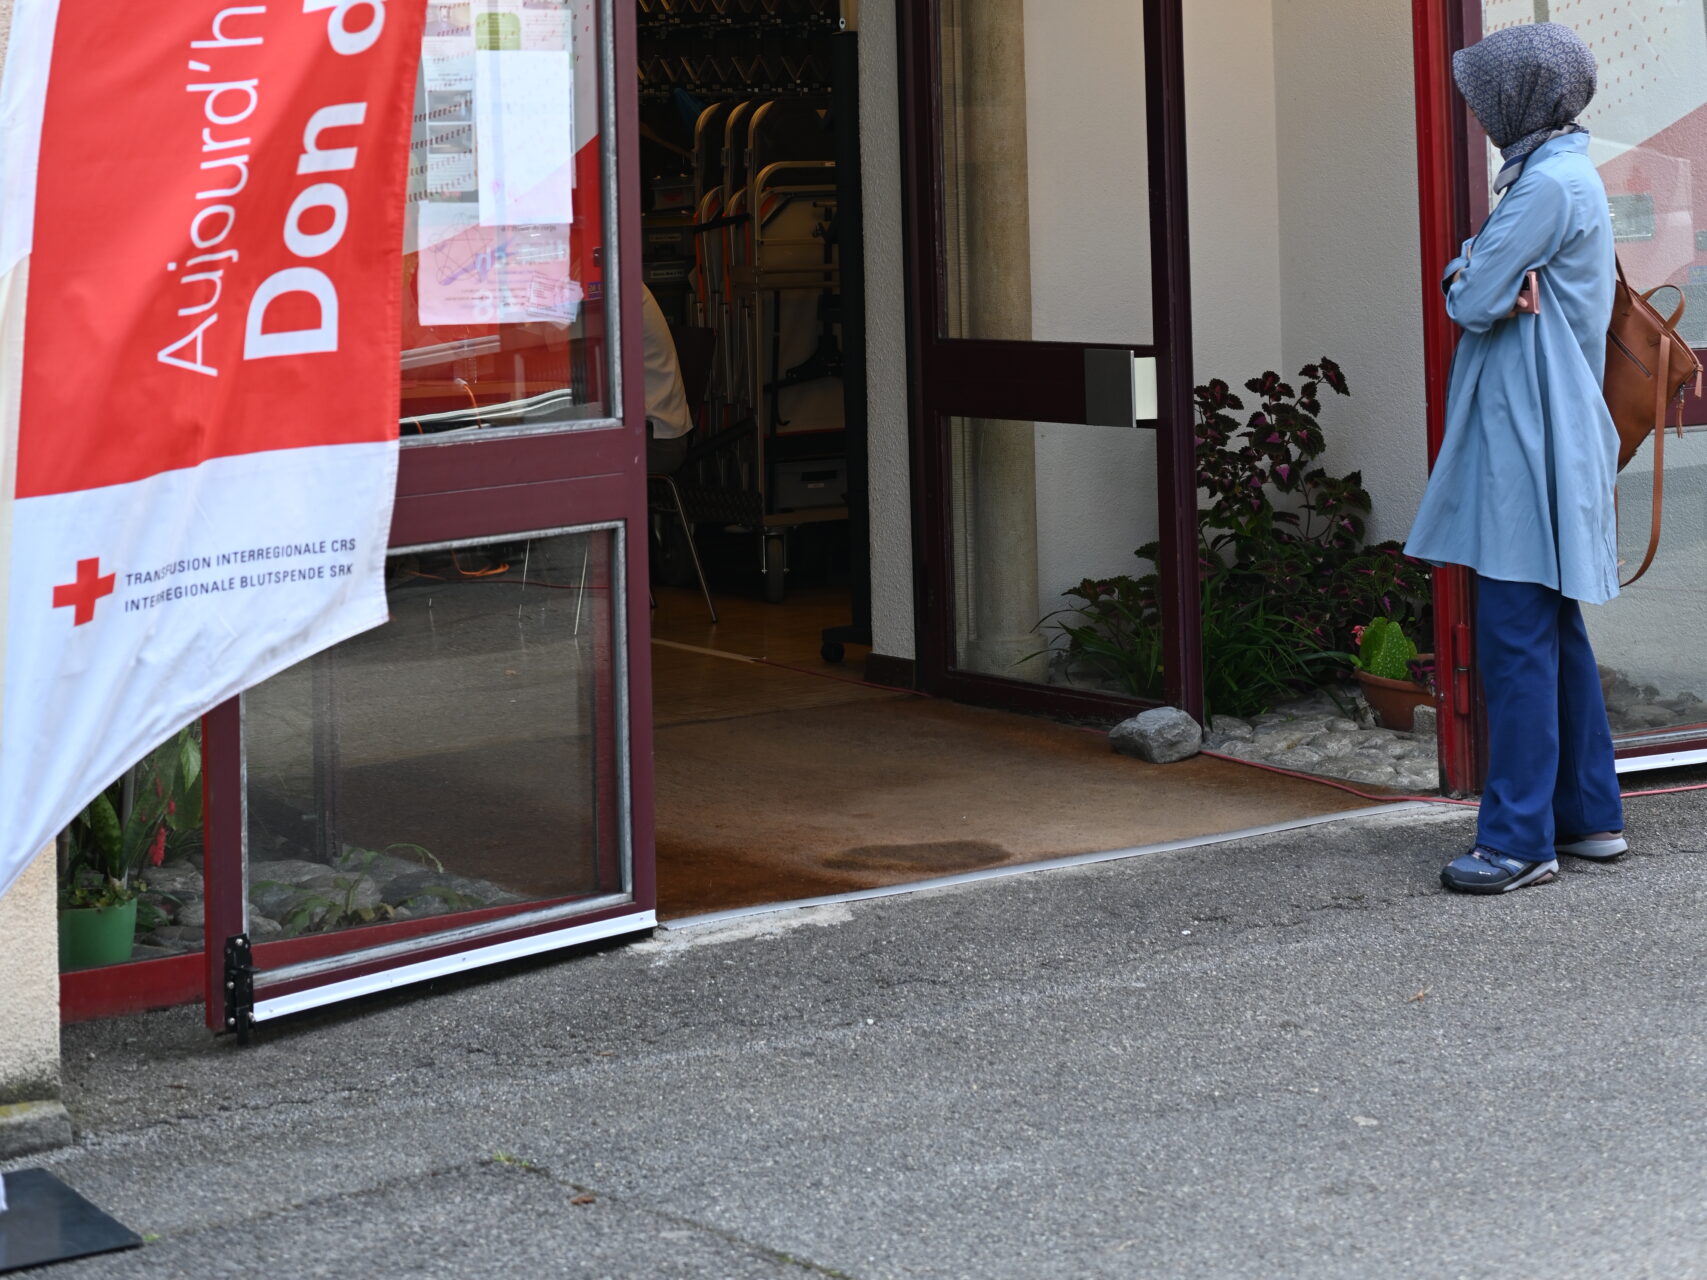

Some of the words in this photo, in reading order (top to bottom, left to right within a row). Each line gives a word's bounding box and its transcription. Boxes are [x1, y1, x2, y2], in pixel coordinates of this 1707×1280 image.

[243, 102, 367, 361] Don
[125, 556, 212, 587] TRANSFUSION
[216, 540, 327, 566] INTERREGIONALE
[330, 538, 357, 553] CRS
[124, 577, 235, 613] INTERREGIONALE
[239, 566, 325, 589] BLUTSPENDE
[329, 563, 354, 578] SRK
